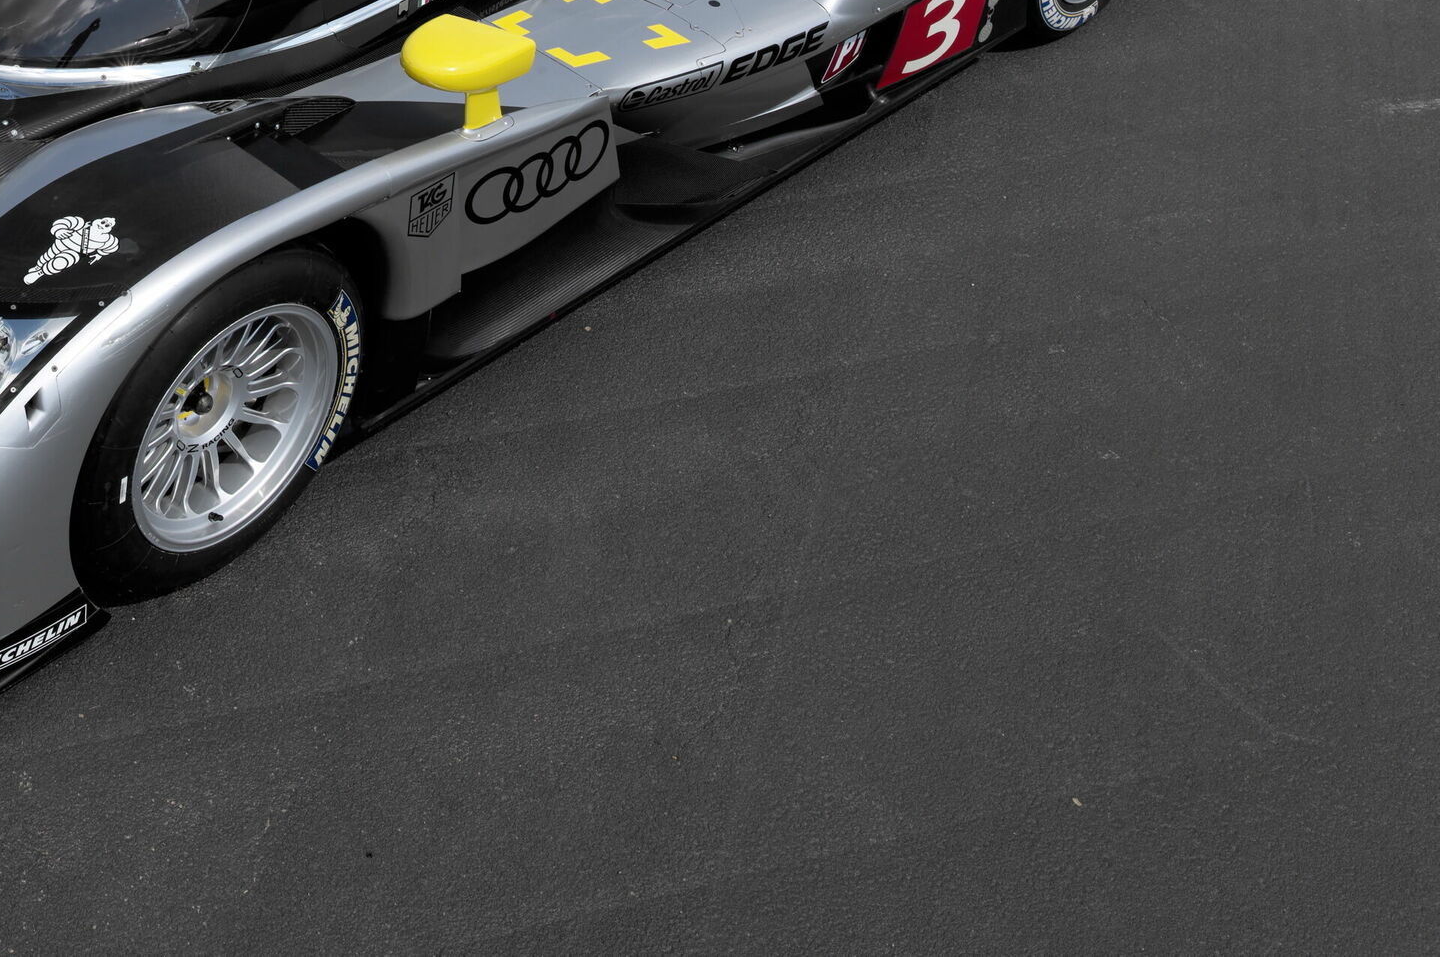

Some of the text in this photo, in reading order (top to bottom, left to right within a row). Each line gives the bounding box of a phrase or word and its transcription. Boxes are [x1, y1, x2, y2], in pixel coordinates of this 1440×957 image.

[719, 20, 830, 86] EDGE
[644, 70, 714, 105] Castrol
[418, 182, 448, 213] TAG
[411, 202, 449, 234] HEUER
[316, 321, 360, 466] MICHELIN
[201, 417, 236, 450] RACING
